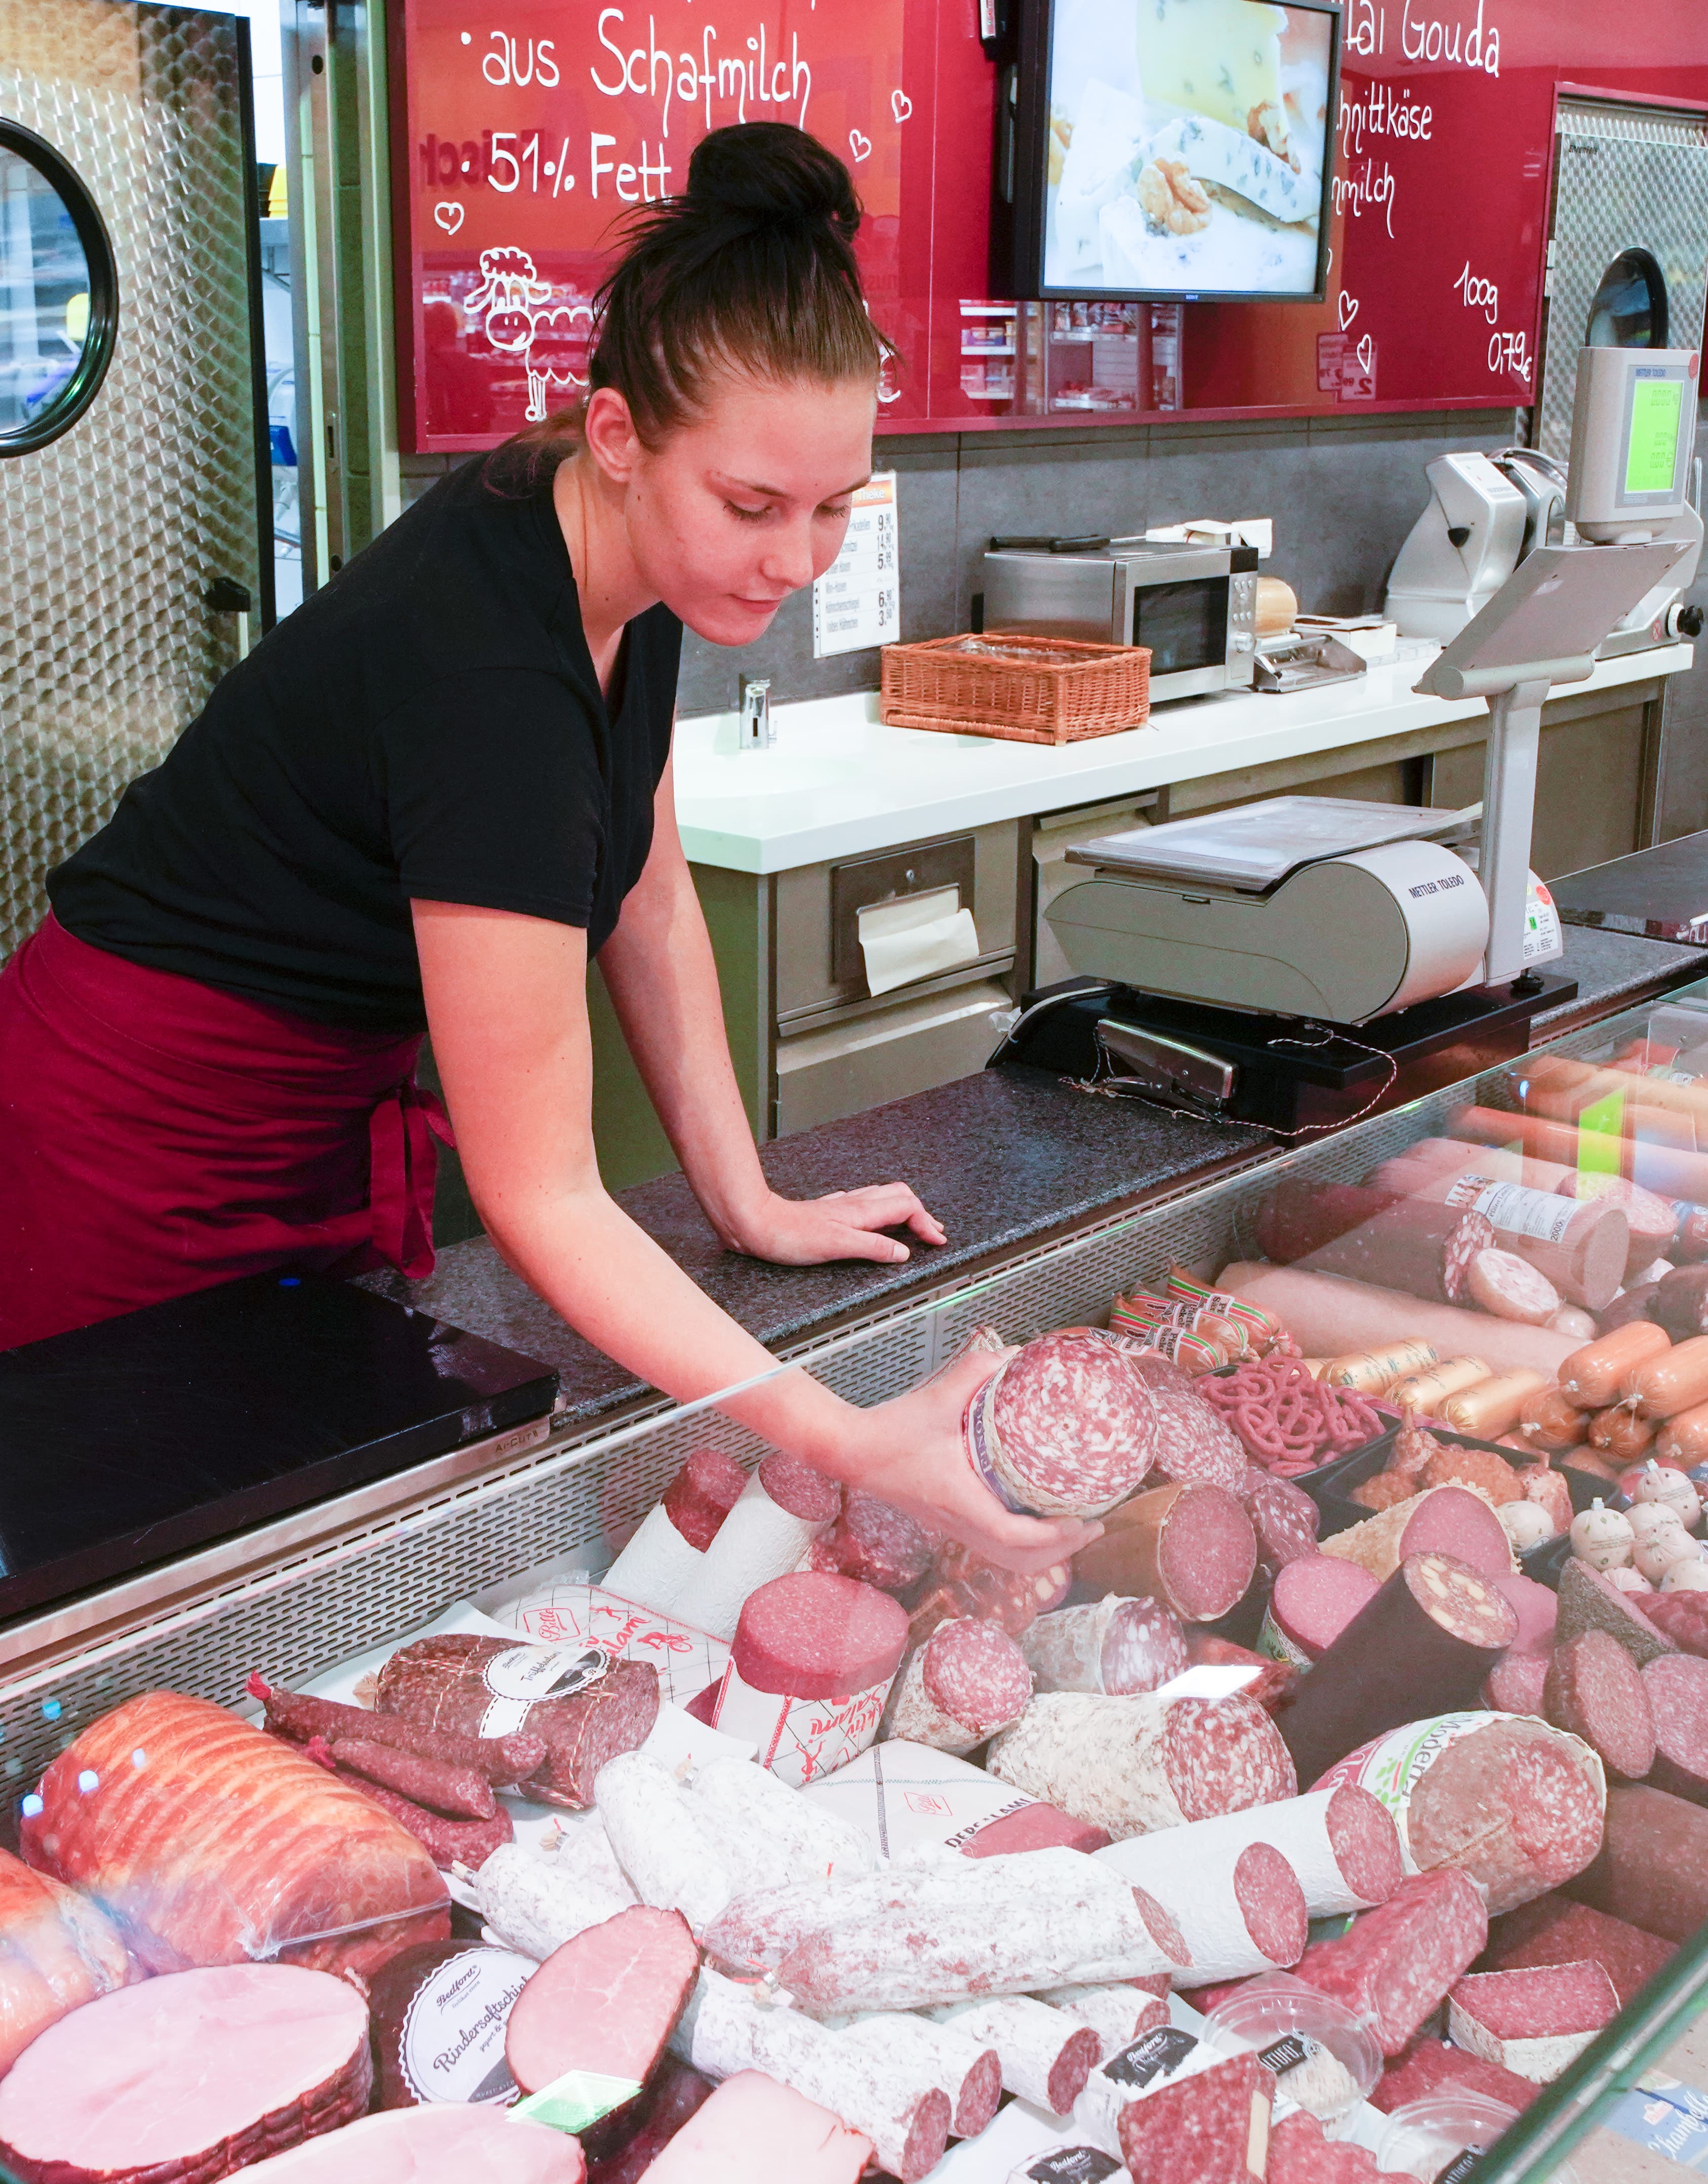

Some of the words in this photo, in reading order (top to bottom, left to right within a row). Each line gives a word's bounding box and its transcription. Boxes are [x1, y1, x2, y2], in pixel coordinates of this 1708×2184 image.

[1402, 0, 1499, 78] Gouda
[482, 31, 560, 88] aus
[590, 8, 811, 138] Schafmilch
[1336, 81, 1433, 158] hnittkäse
[487, 132, 576, 198] 51%
[591, 132, 673, 202] Fett
[1453, 260, 1498, 324] 100g
[858, 488, 884, 501] Theke
[1408, 882, 1440, 899] METTLER
[1436, 875, 1465, 891] TOLEDO
[808, 1683, 887, 1744] Salami
